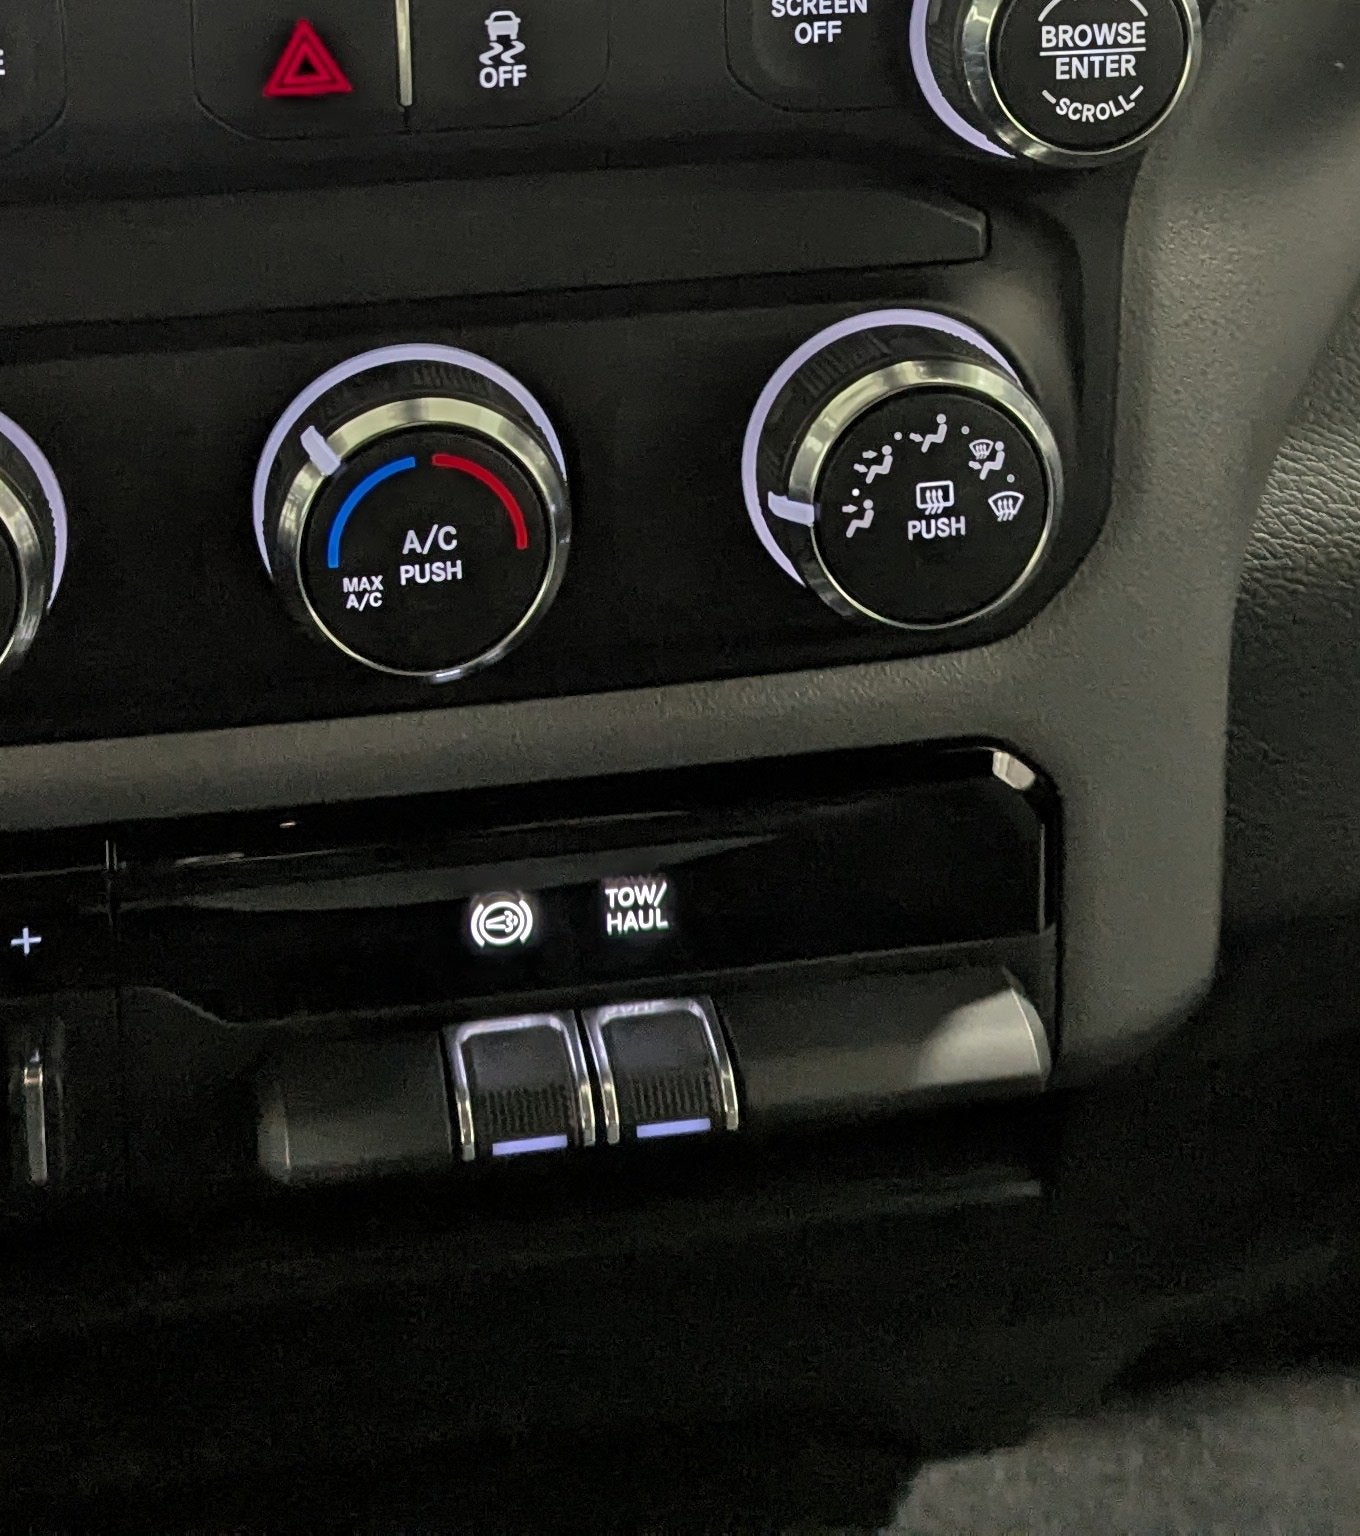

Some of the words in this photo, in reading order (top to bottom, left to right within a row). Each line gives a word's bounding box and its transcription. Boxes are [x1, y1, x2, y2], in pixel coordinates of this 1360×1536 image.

[794, 21, 842, 45] OFF
[1041, 21, 1146, 49] BROWSE
[479, 64, 528, 89] OFF
[1055, 55, 1137, 80] ENTER
[1055, 96, 1136, 123] SCROLL
[402, 524, 458, 555] A/C
[907, 515, 966, 541] PUSH
[343, 574, 384, 593] MAX
[399, 559, 463, 586] PUSH
[346, 592, 383, 612] A/C
[605, 880, 667, 908] TOW/
[606, 907, 669, 935] HAUL
